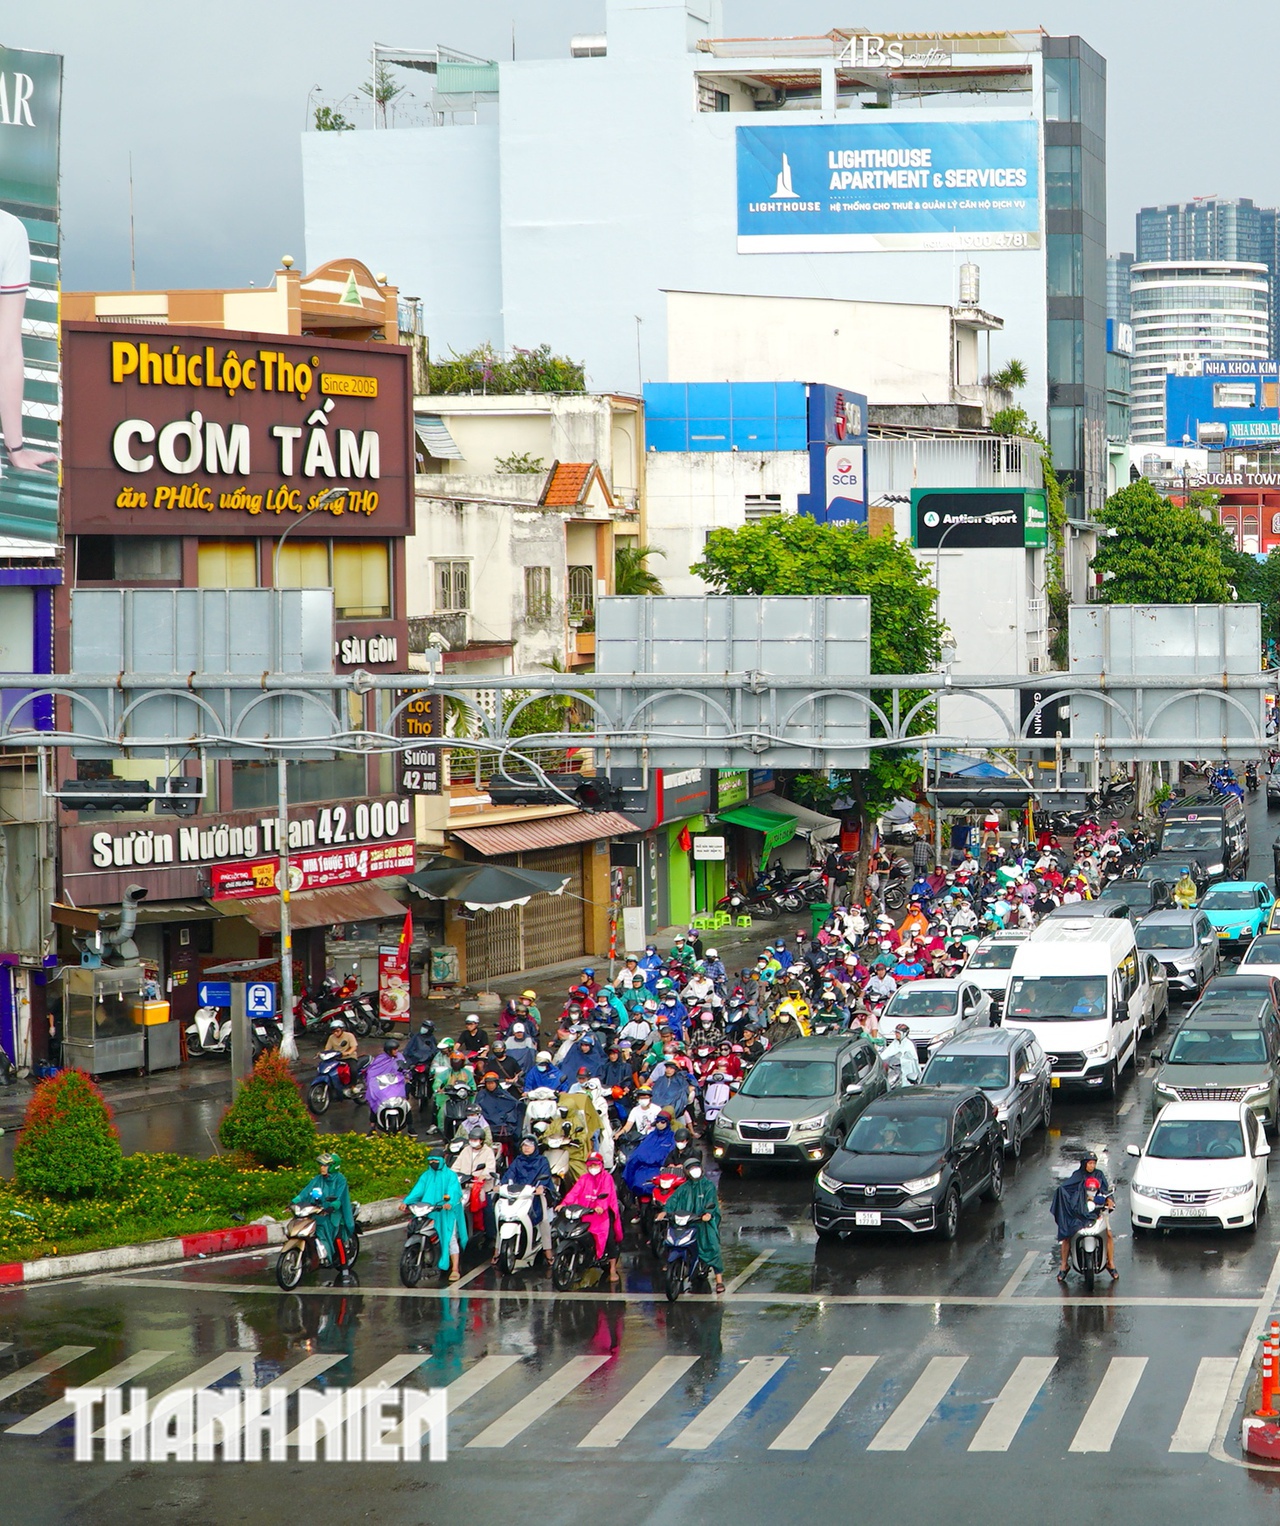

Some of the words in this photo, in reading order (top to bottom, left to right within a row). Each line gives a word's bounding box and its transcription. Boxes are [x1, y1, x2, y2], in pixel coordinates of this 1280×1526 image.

[837, 35, 904, 69] 4Bs
[907, 47, 948, 69] rooftop
[828, 149, 932, 169] LIGHTHOUSE
[829, 170, 929, 190] APARTMENT
[933, 173, 944, 188] &
[945, 168, 1027, 188] SERVICES
[749, 201, 821, 213] LIGHTHOUSE
[829, 202, 841, 213] HỆ
[842, 199, 871, 212] THỐNG
[873, 201, 890, 211] CHO
[892, 199, 913, 210] THUÊ
[995, 233, 1028, 248] 4781
[112, 341, 202, 386] Phúc
[205, 346, 256, 397] Lộc
[260, 349, 313, 401] Thọ
[1206, 361, 1227, 373] NHA
[1228, 361, 1257, 373] KHOA
[1258, 361, 1277, 373] KIM
[323, 376, 350, 393] Since
[352, 378, 376, 395] 2005
[113, 410, 250, 475] CƠM
[272, 397, 380, 479] TẤM
[1231, 424, 1249, 436] NHA
[1250, 423, 1270, 436] KHOA
[832, 475, 858, 485] SCB
[1199, 473, 1243, 485] SUGAR
[117, 487, 148, 510] ăn
[154, 482, 214, 512] PHÚC,
[220, 486, 262, 515] uống
[266, 483, 303, 515] LỘC,
[348, 489, 379, 516] THỌ
[984, 513, 1017, 525] Sport
[342, 636, 366, 665] SÀI
[368, 634, 398, 663] GÒN
[407, 698, 431, 716] Lộc
[407, 719, 432, 737] Thọ
[404, 750, 435, 766] Sườn
[403, 771, 420, 790] 42
[92, 830, 173, 868] Sườn
[179, 823, 258, 862] Nướng
[318, 798, 411, 844] 42.000đ
